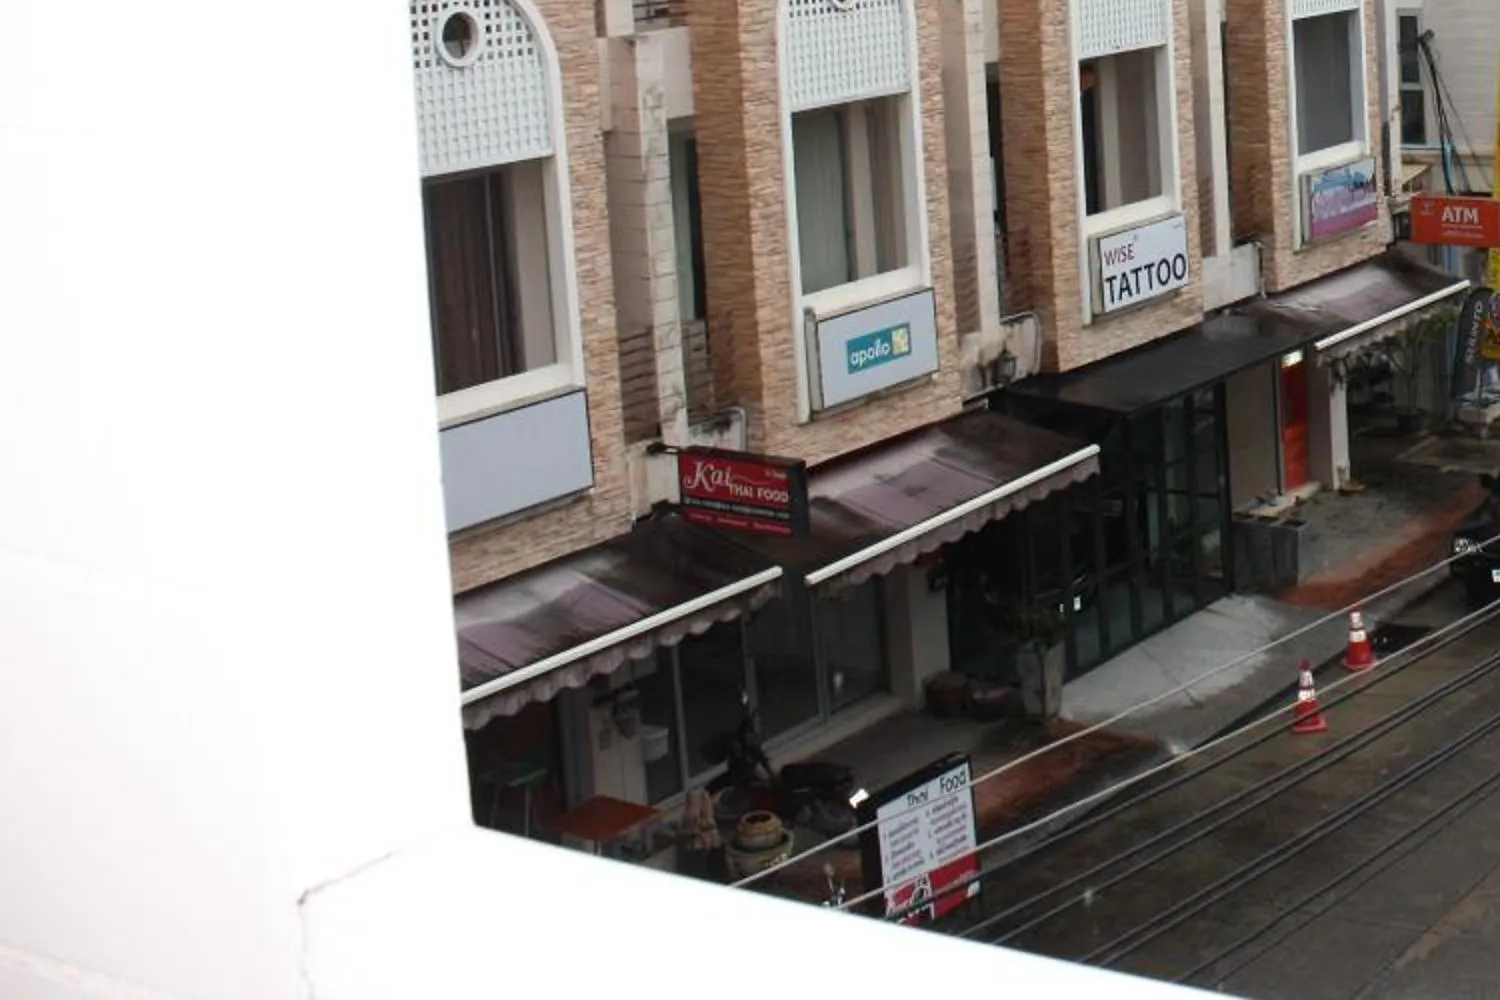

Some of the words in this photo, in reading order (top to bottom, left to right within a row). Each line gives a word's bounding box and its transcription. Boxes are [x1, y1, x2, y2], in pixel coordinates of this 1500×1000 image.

[1441, 206, 1480, 225] ATM
[1104, 243, 1135, 267] WISE
[1105, 253, 1187, 305] TATTOO
[684, 461, 732, 493] Kai
[729, 483, 753, 498] THAI
[757, 486, 790, 504] FOOD
[939, 771, 967, 794] Food
